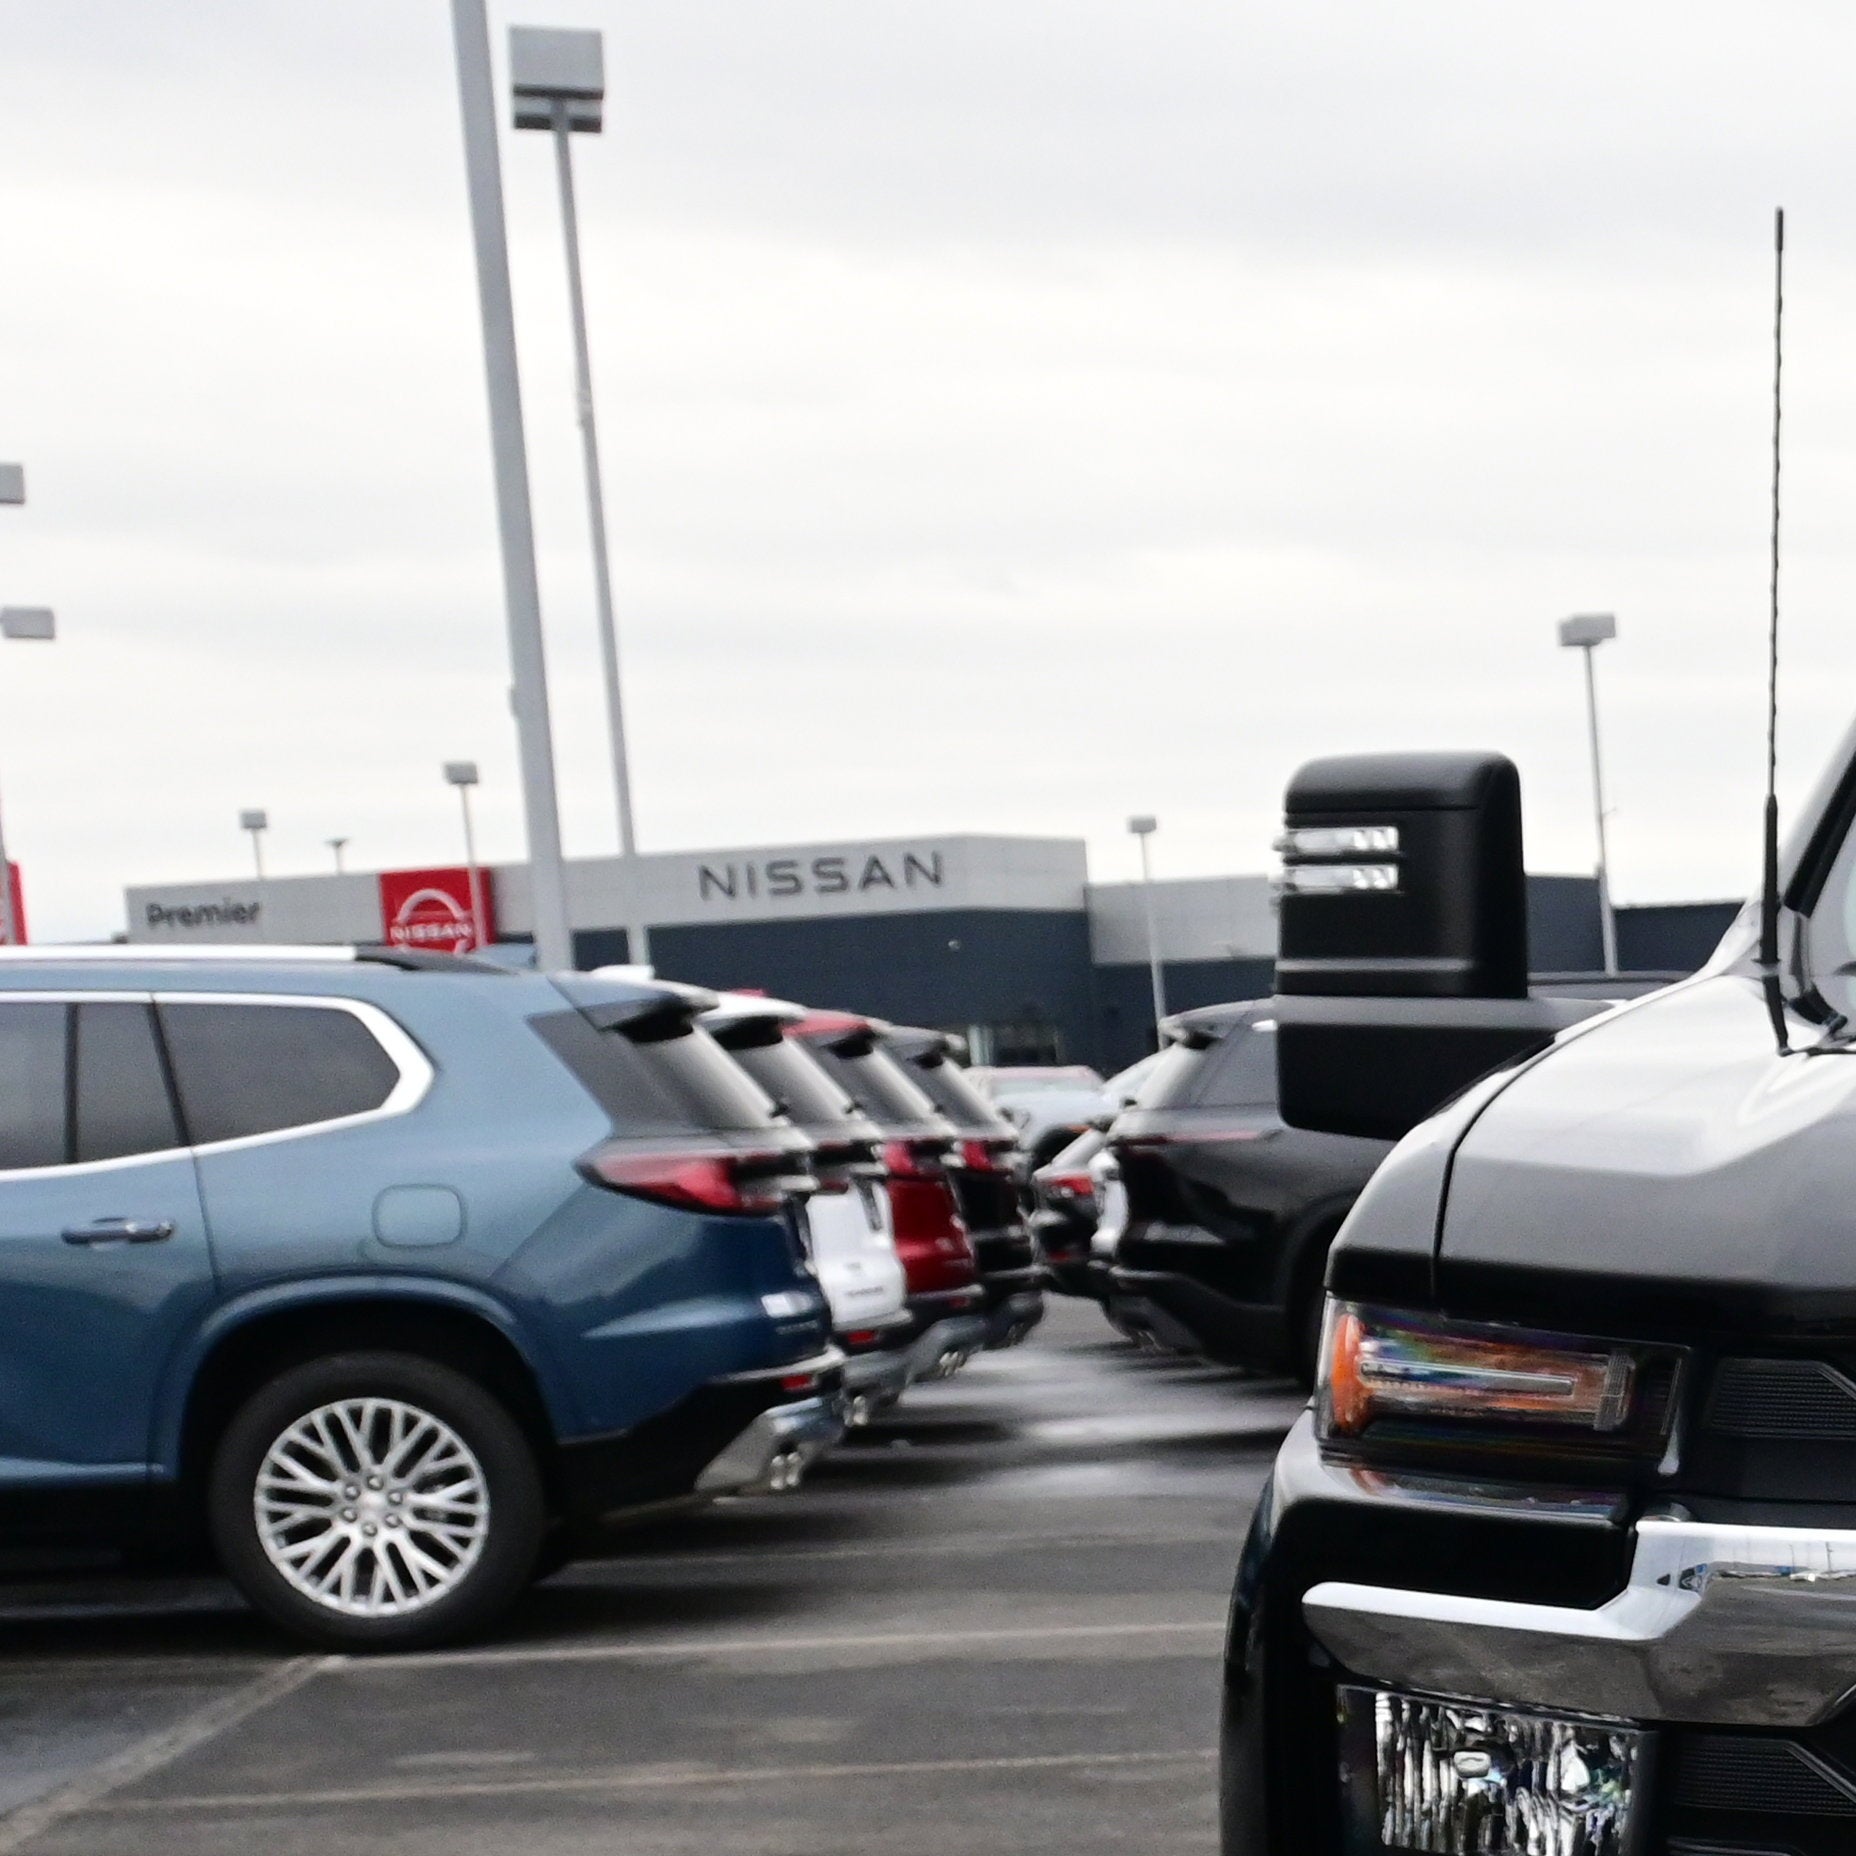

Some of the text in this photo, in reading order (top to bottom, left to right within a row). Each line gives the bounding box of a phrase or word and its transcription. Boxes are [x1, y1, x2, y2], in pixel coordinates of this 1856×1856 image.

[699, 851, 943, 901] NISSAN
[147, 898, 259, 929] Premier
[391, 923, 472, 940] NISSAN
